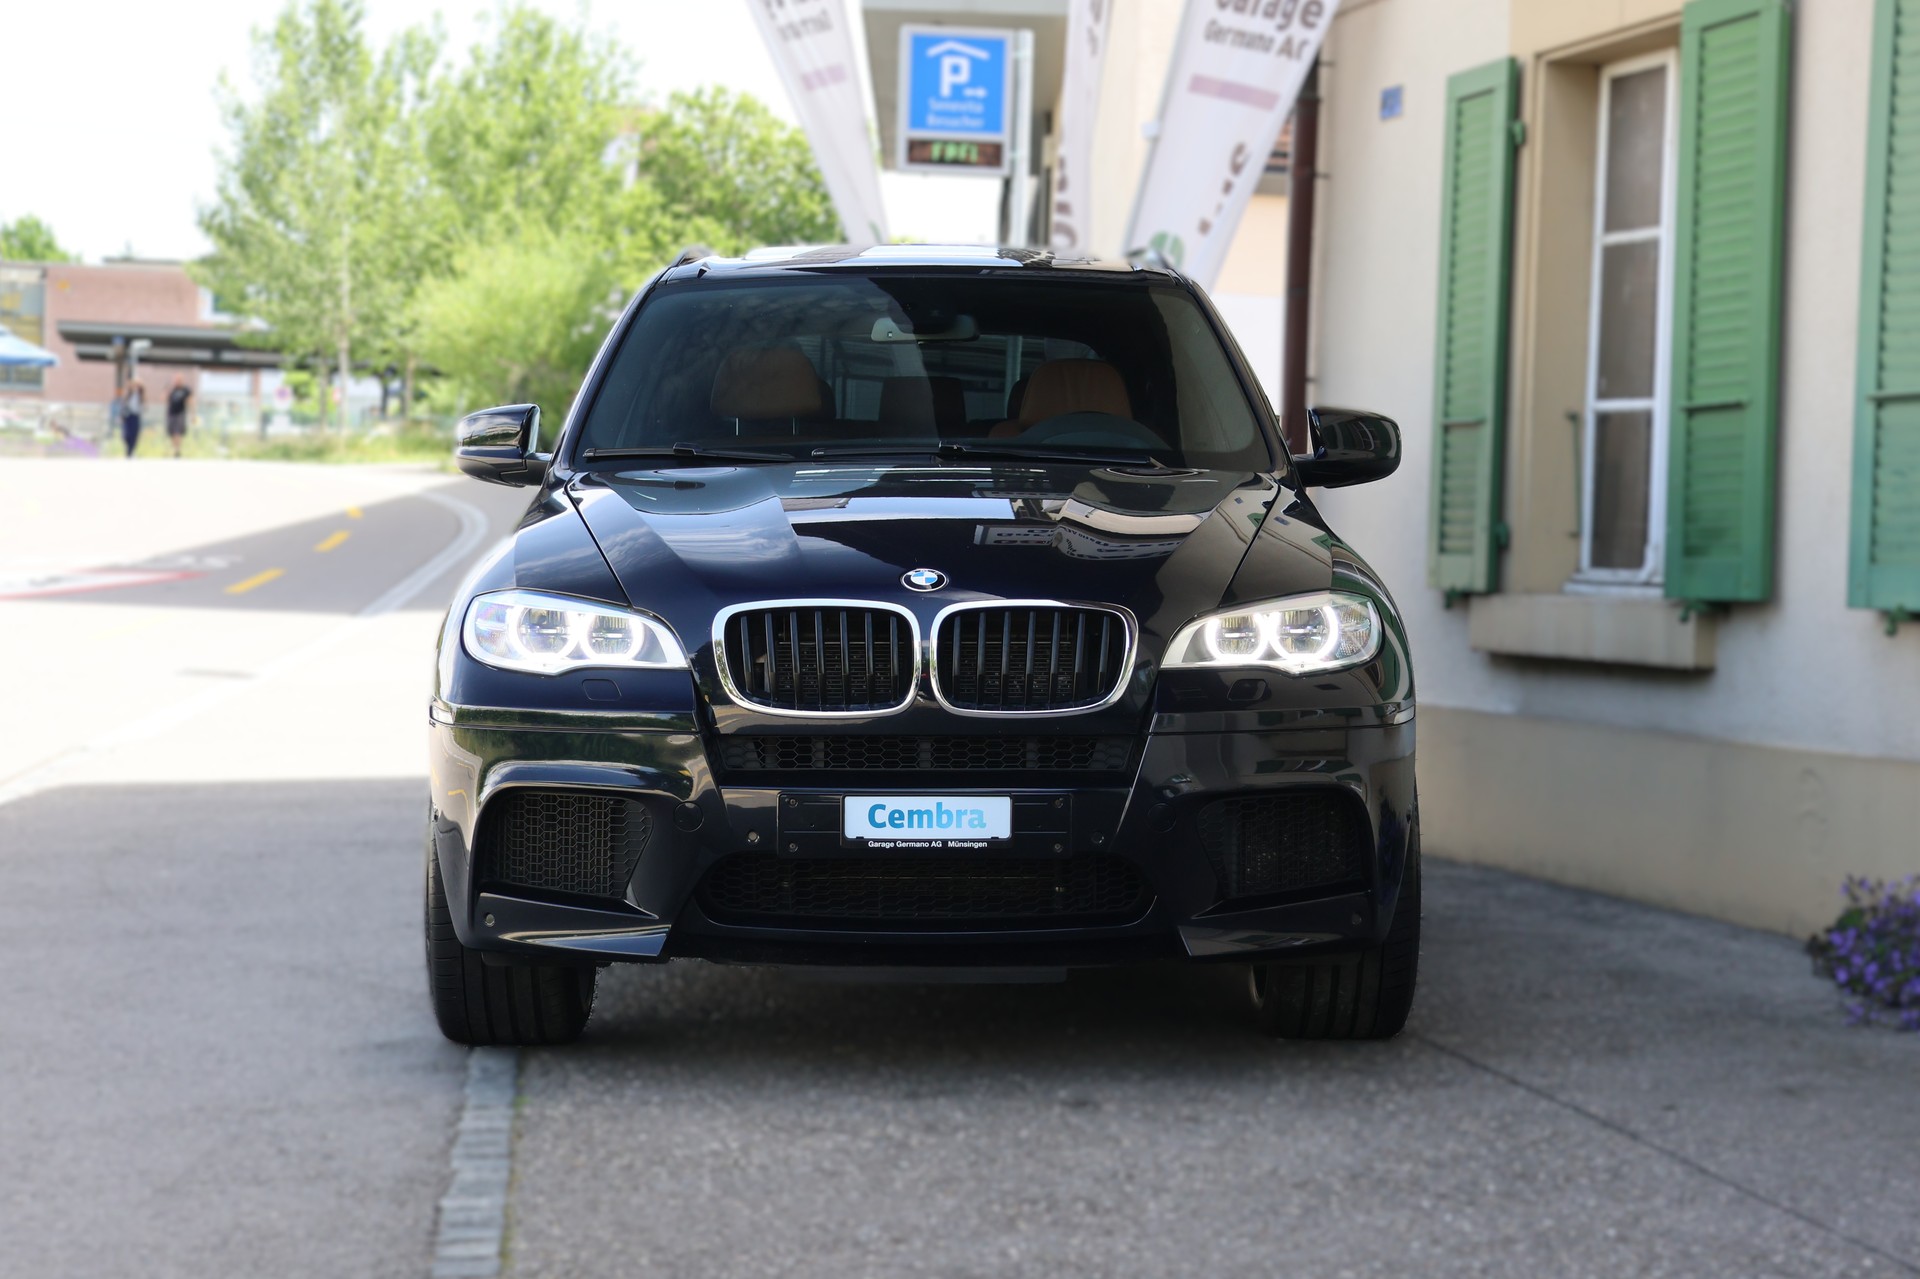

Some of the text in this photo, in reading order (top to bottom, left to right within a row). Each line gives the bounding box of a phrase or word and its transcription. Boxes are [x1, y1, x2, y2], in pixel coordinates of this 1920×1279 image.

[940, 54, 971, 98] P
[868, 801, 987, 829] Cembra
[868, 840, 988, 849] Garage Germano AG Münsingen
